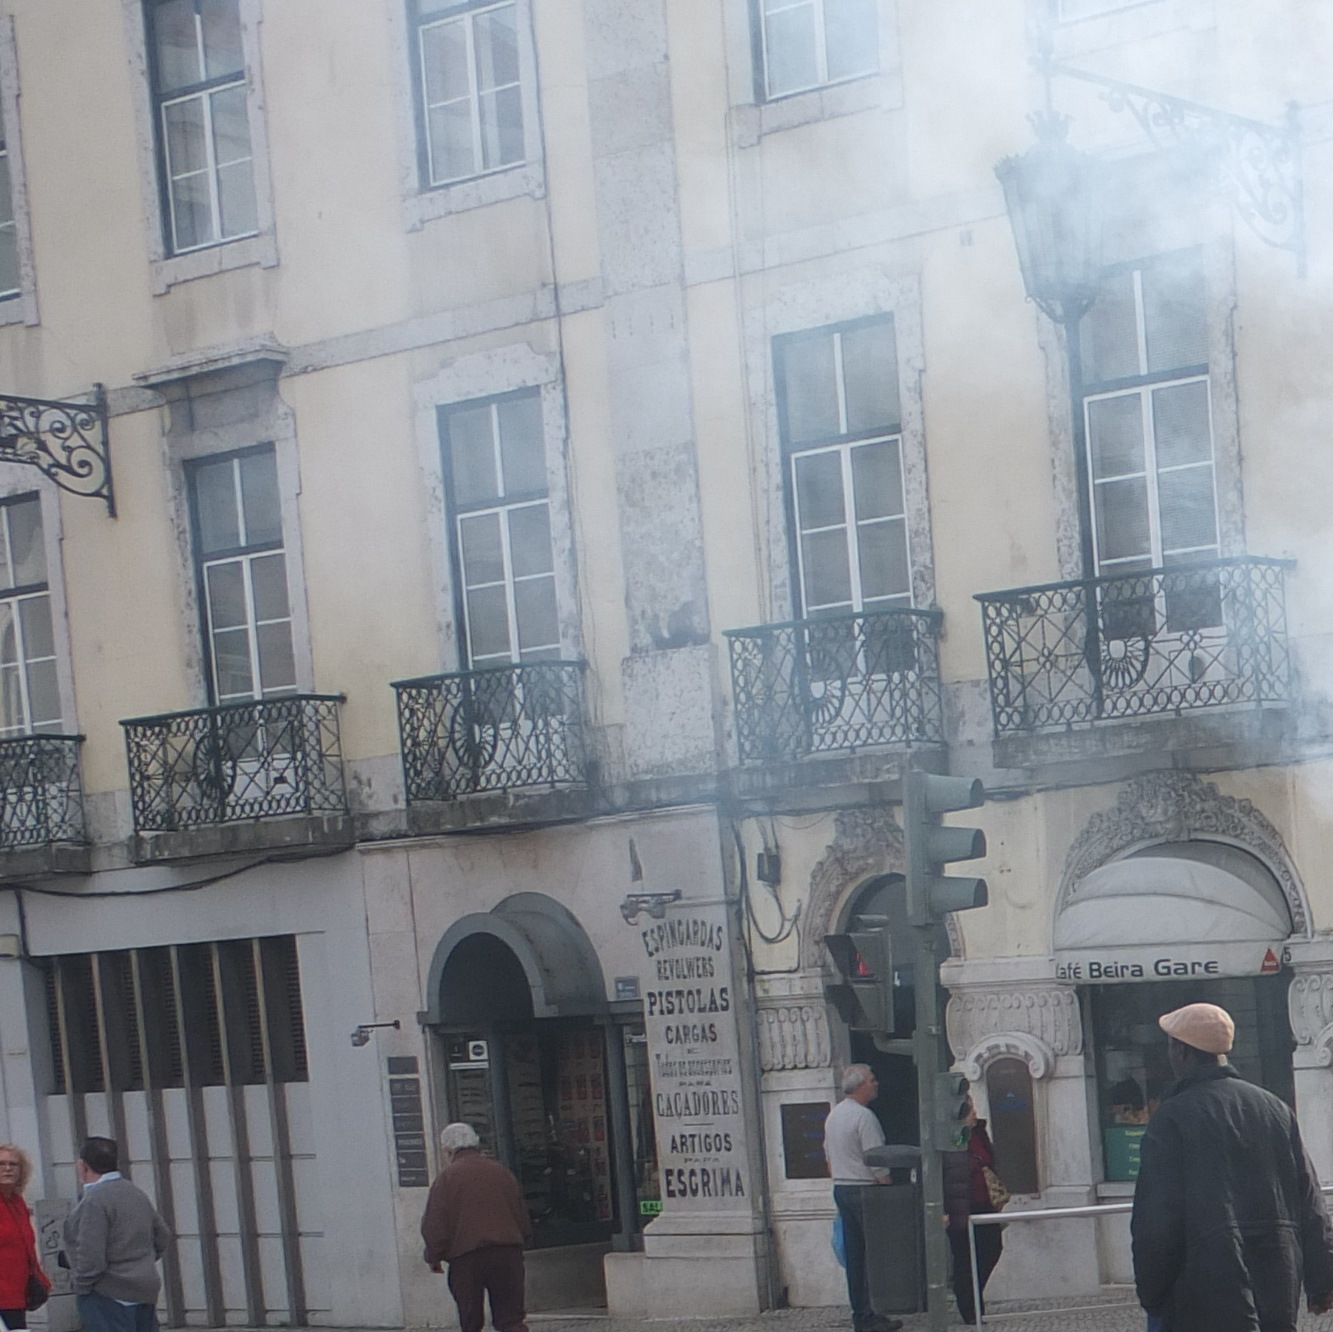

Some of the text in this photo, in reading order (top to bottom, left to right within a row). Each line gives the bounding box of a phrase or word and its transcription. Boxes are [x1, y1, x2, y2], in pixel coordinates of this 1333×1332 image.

[641, 919, 724, 958] ESPINGARDAS
[656, 956, 716, 982] REVOLWERS
[1088, 960, 1144, 979] Beira
[1153, 958, 1220, 976] Gare
[647, 987, 730, 1016] PISTOLAS
[665, 1023, 718, 1044] CARGAS
[656, 1090, 740, 1119] CAÇADORES
[670, 1132, 733, 1154] ARTIGOS
[665, 1167, 746, 1198] ESGRIMA
